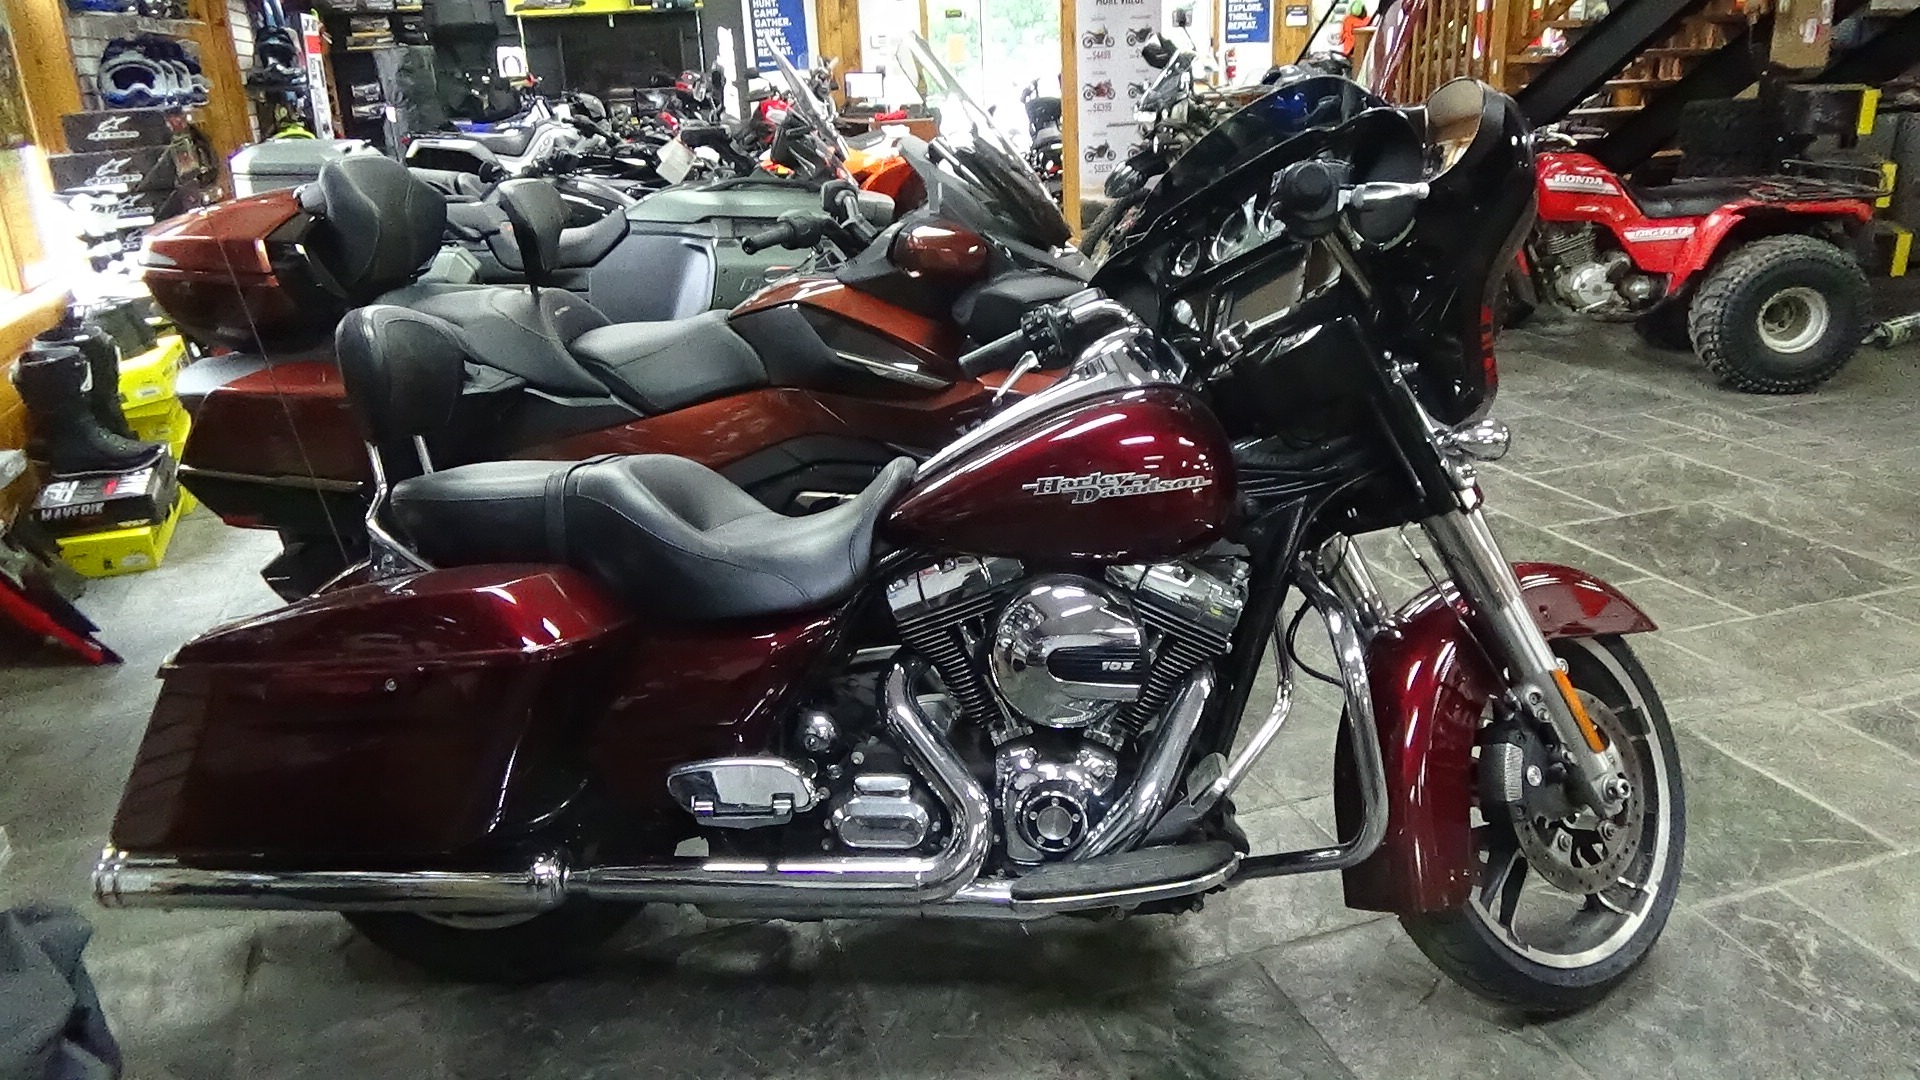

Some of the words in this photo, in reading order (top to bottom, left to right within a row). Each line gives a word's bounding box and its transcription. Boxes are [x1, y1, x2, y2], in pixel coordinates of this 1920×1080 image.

[753, 8, 782, 18] CAMP.
[754, 17, 792, 28] GATHER.
[1227, 21, 1258, 30] REPEAT.
[1554, 174, 1603, 186] HONDA
[1033, 472, 1138, 496] Harley
[1072, 475, 1207, 504] Davidson
